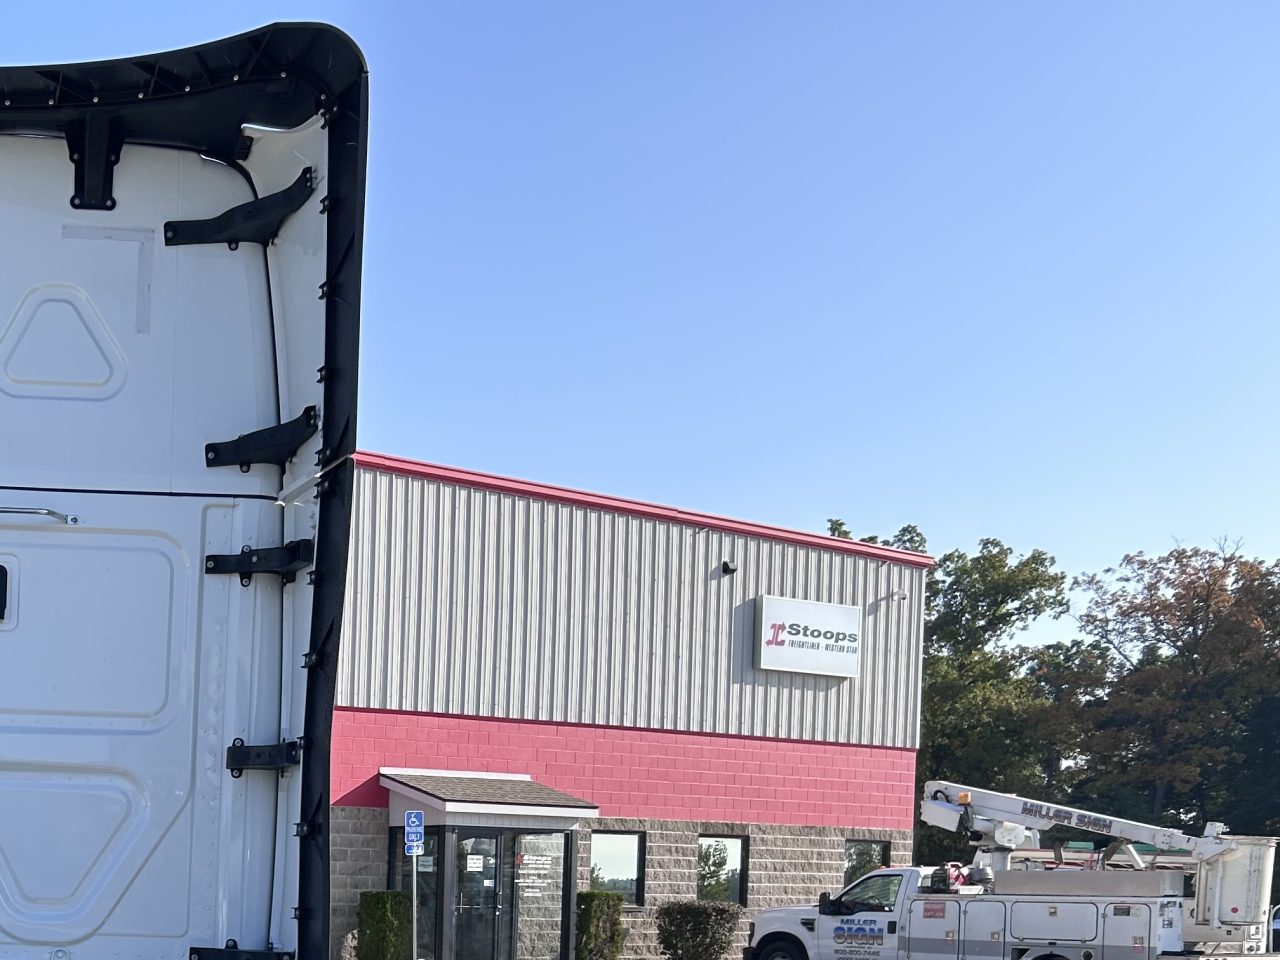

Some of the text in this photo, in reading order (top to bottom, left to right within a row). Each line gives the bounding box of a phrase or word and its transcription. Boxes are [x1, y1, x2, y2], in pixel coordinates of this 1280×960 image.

[786, 623, 858, 643] Stoops
[1021, 802, 1113, 833] MILLER SIGN
[840, 918, 877, 926] MILLER
[833, 926, 884, 946] SIGN
